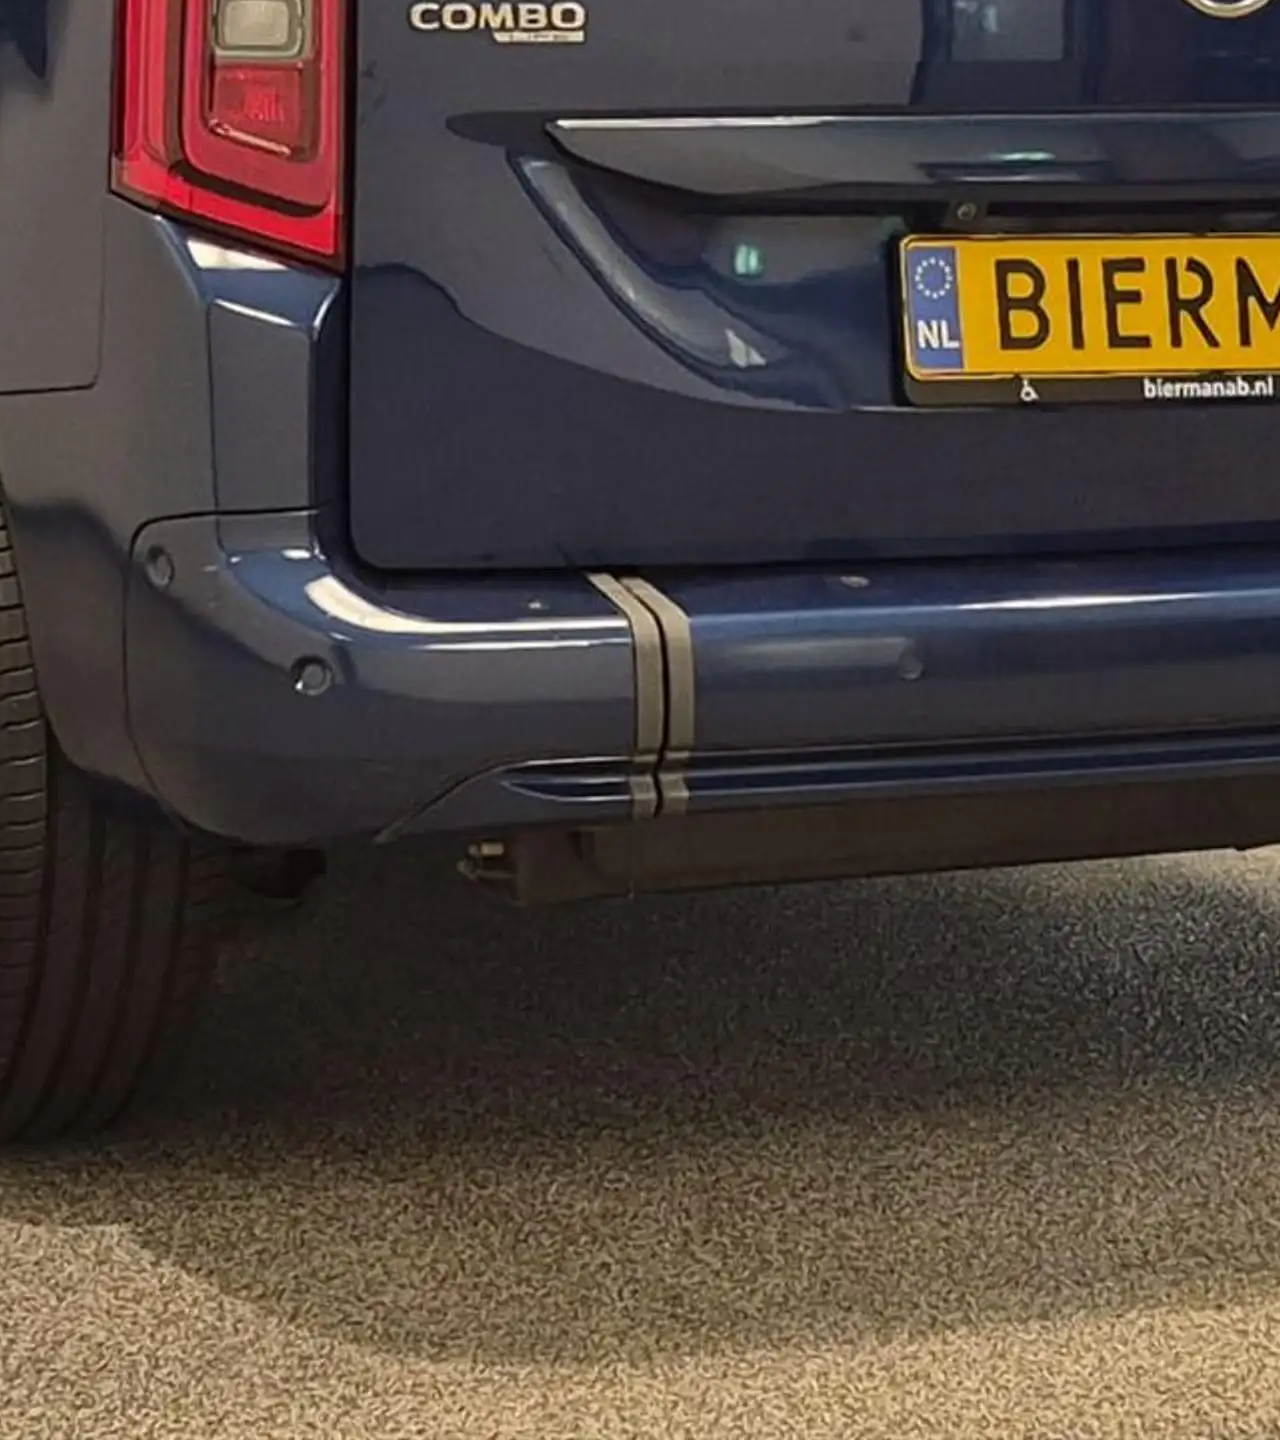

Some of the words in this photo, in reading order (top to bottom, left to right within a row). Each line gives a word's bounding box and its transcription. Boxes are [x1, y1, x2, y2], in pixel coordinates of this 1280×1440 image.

[409, 1, 586, 31] COMBO
[917, 319, 961, 349] NL
[1143, 376, 1275, 400] biermanab.nl
